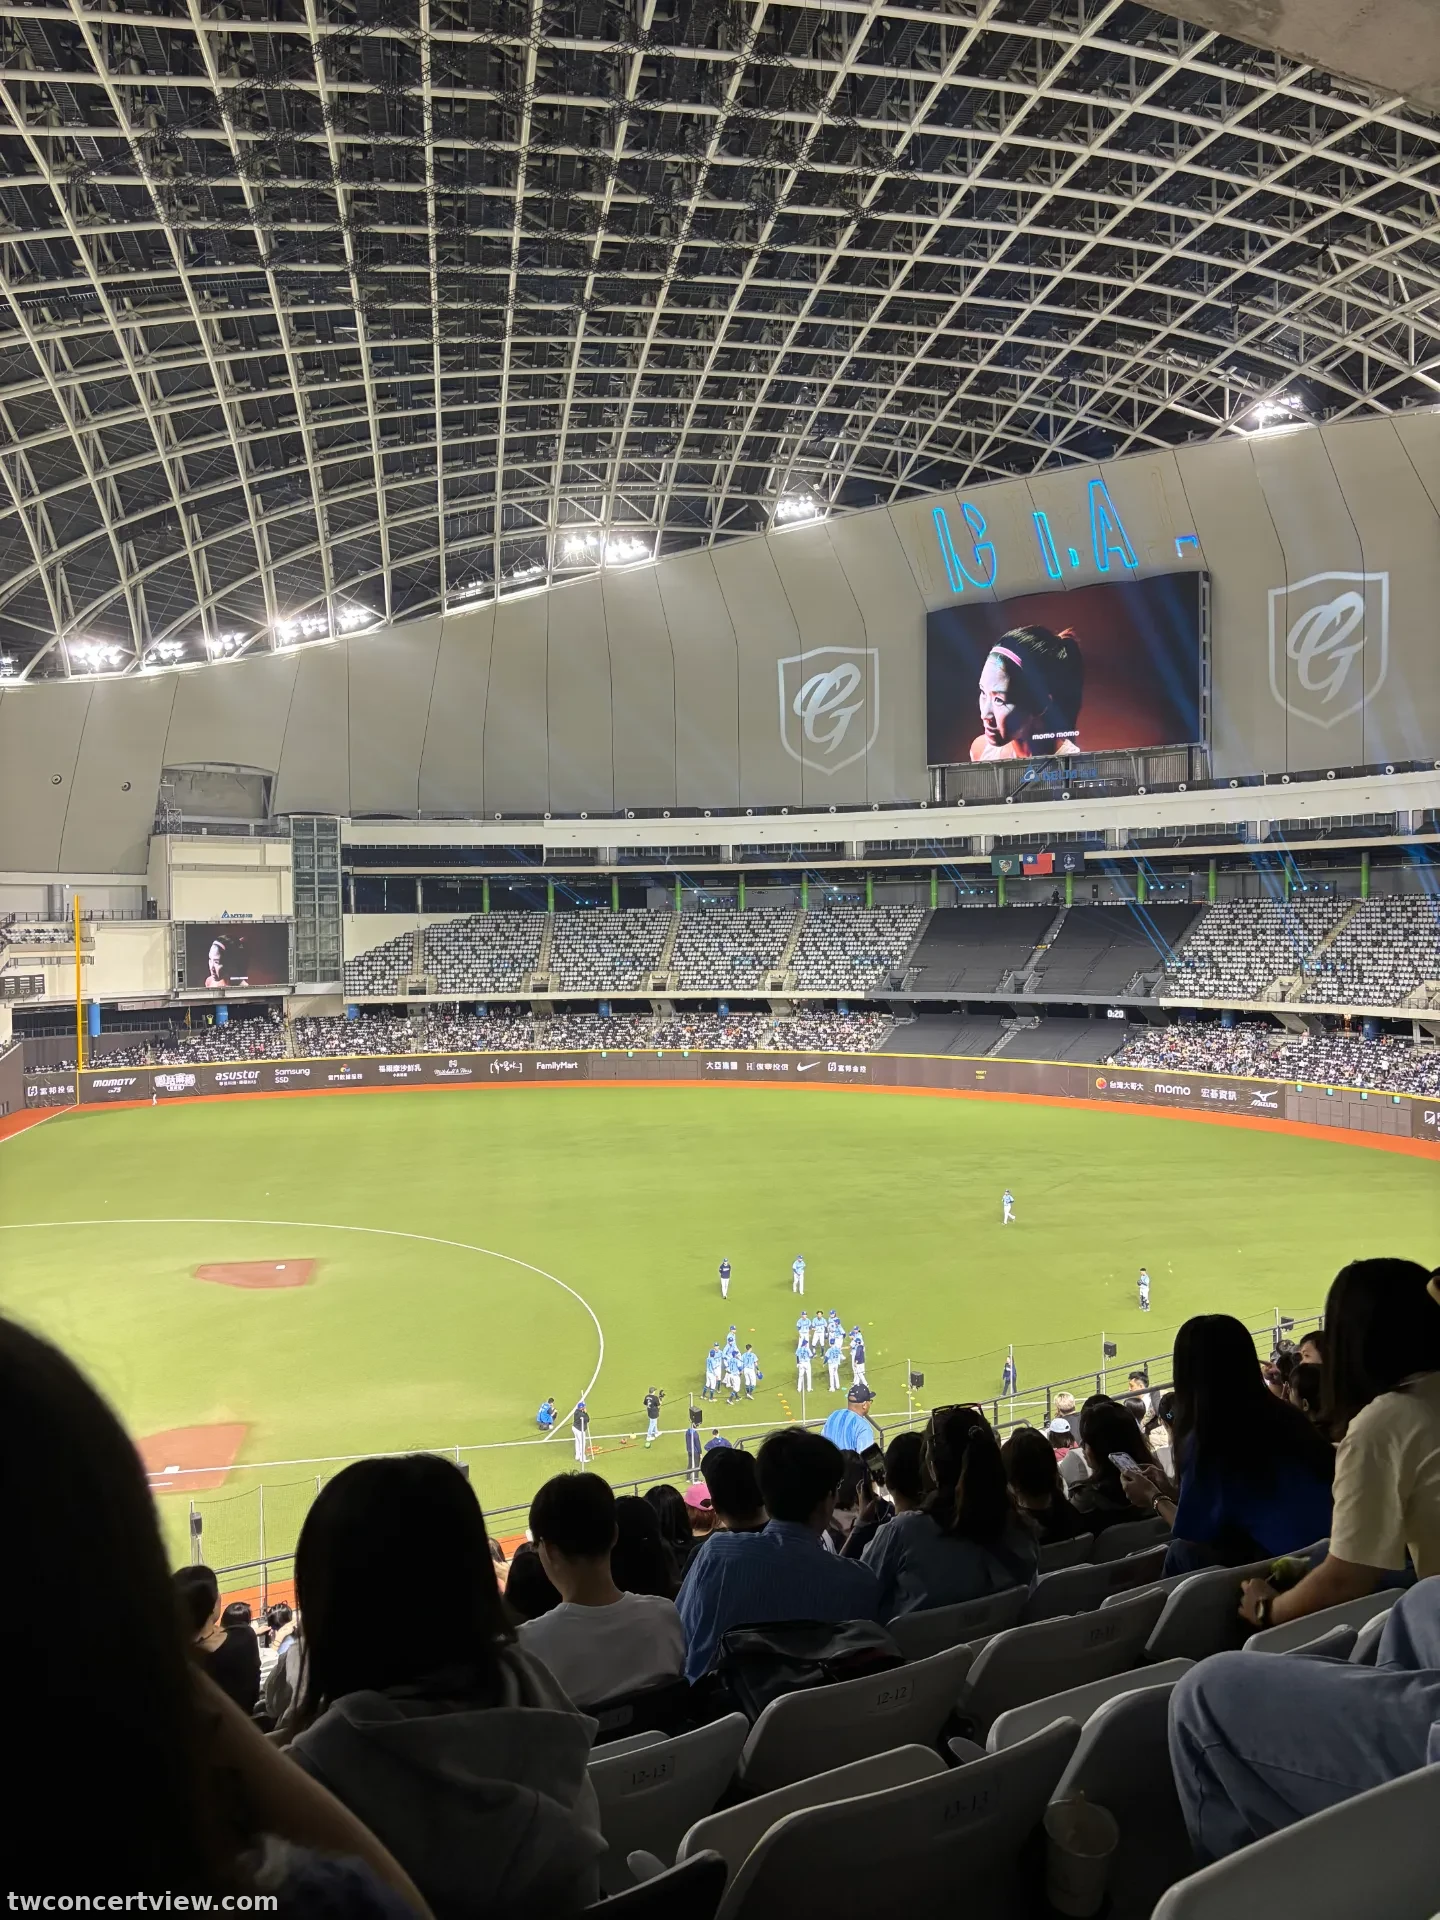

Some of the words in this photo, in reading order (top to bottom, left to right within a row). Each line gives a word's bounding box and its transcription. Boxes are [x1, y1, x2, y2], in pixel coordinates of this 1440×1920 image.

[1032, 733, 1055, 741] momo
[1056, 730, 1080, 739] momo
[1107, 1009, 1124, 1019] 0:20
[536, 1061, 578, 1071] FamilyMart
[215, 1070, 260, 1081] asustor
[275, 1068, 310, 1077] Samsung
[275, 1076, 289, 1084] SSD
[1109, 1080, 1144, 1092] 台灣大哥大
[1154, 1083, 1191, 1096] momo
[876, 1686, 907, 1706] 12-12
